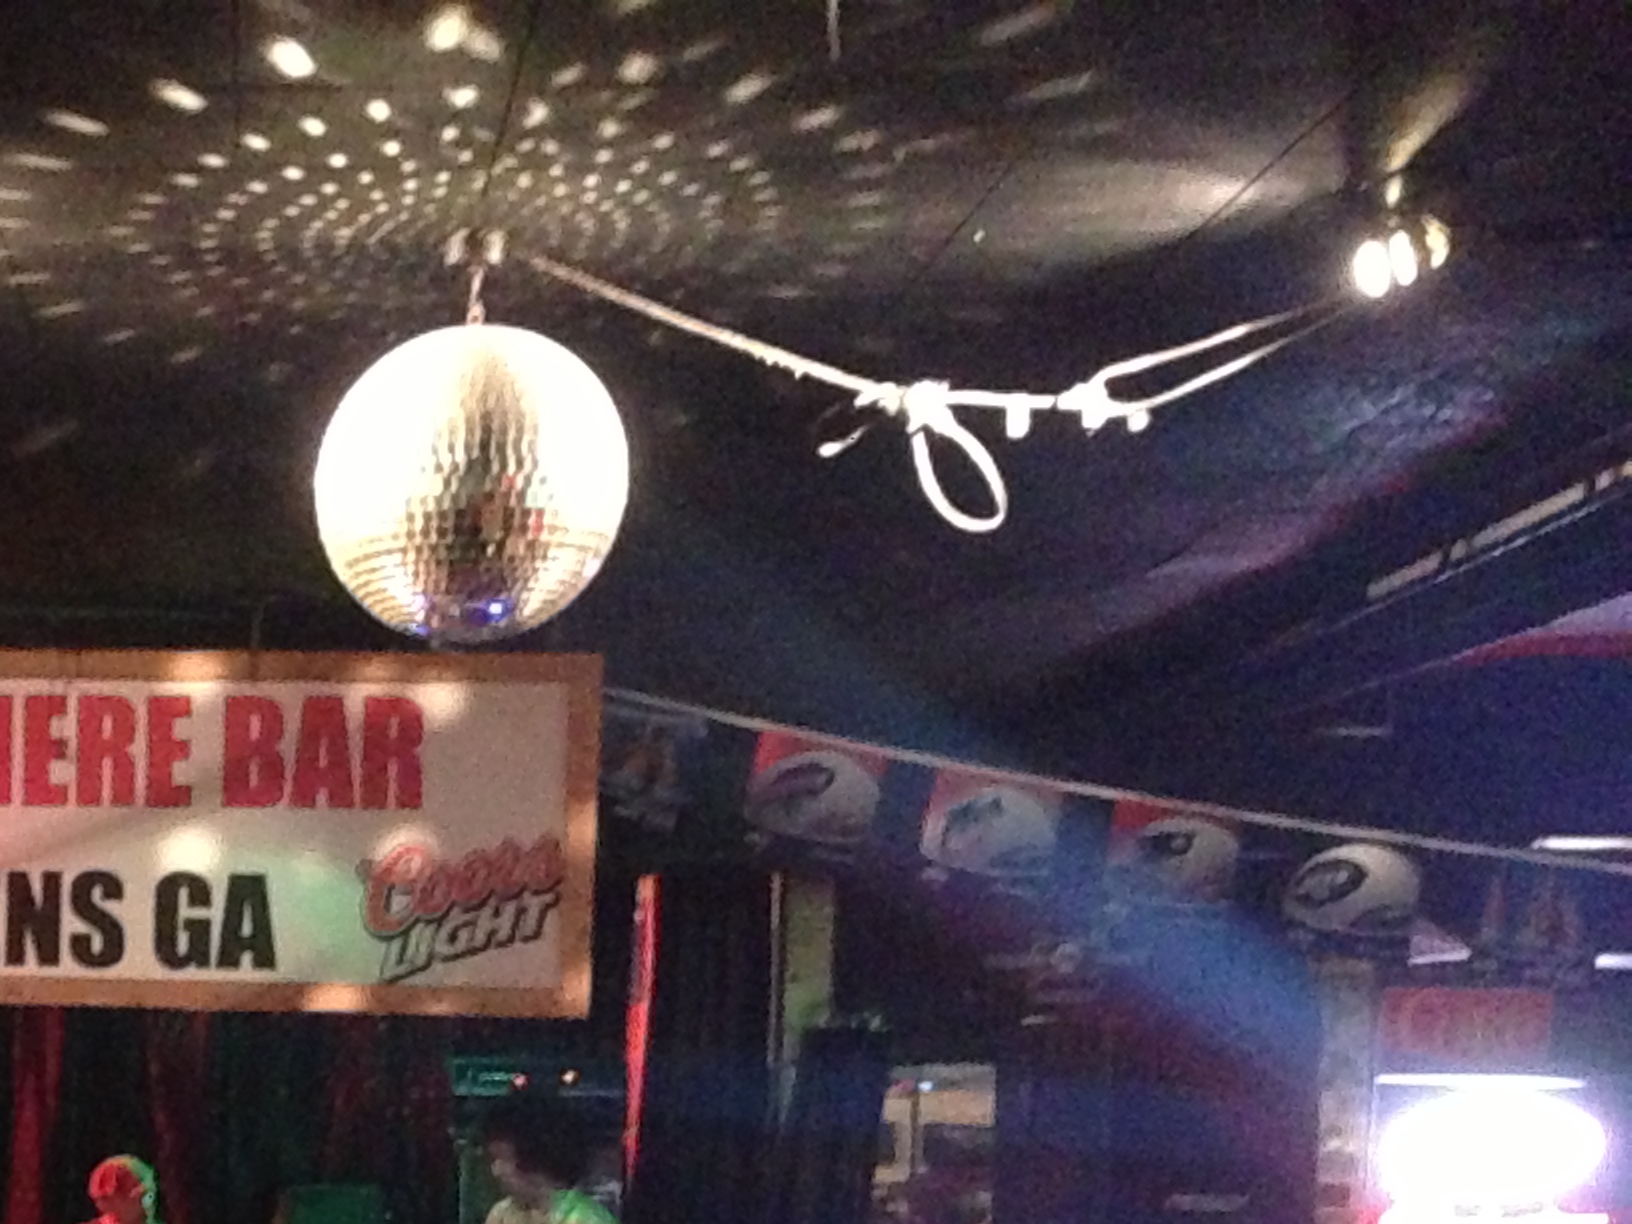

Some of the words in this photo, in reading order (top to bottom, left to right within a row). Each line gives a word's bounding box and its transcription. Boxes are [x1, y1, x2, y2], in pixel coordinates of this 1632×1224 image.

[222, 696, 424, 810] BAR
[153, 871, 276, 971] GA
[357, 834, 563, 940] Coors
[379, 889, 560, 983] LIGHT
